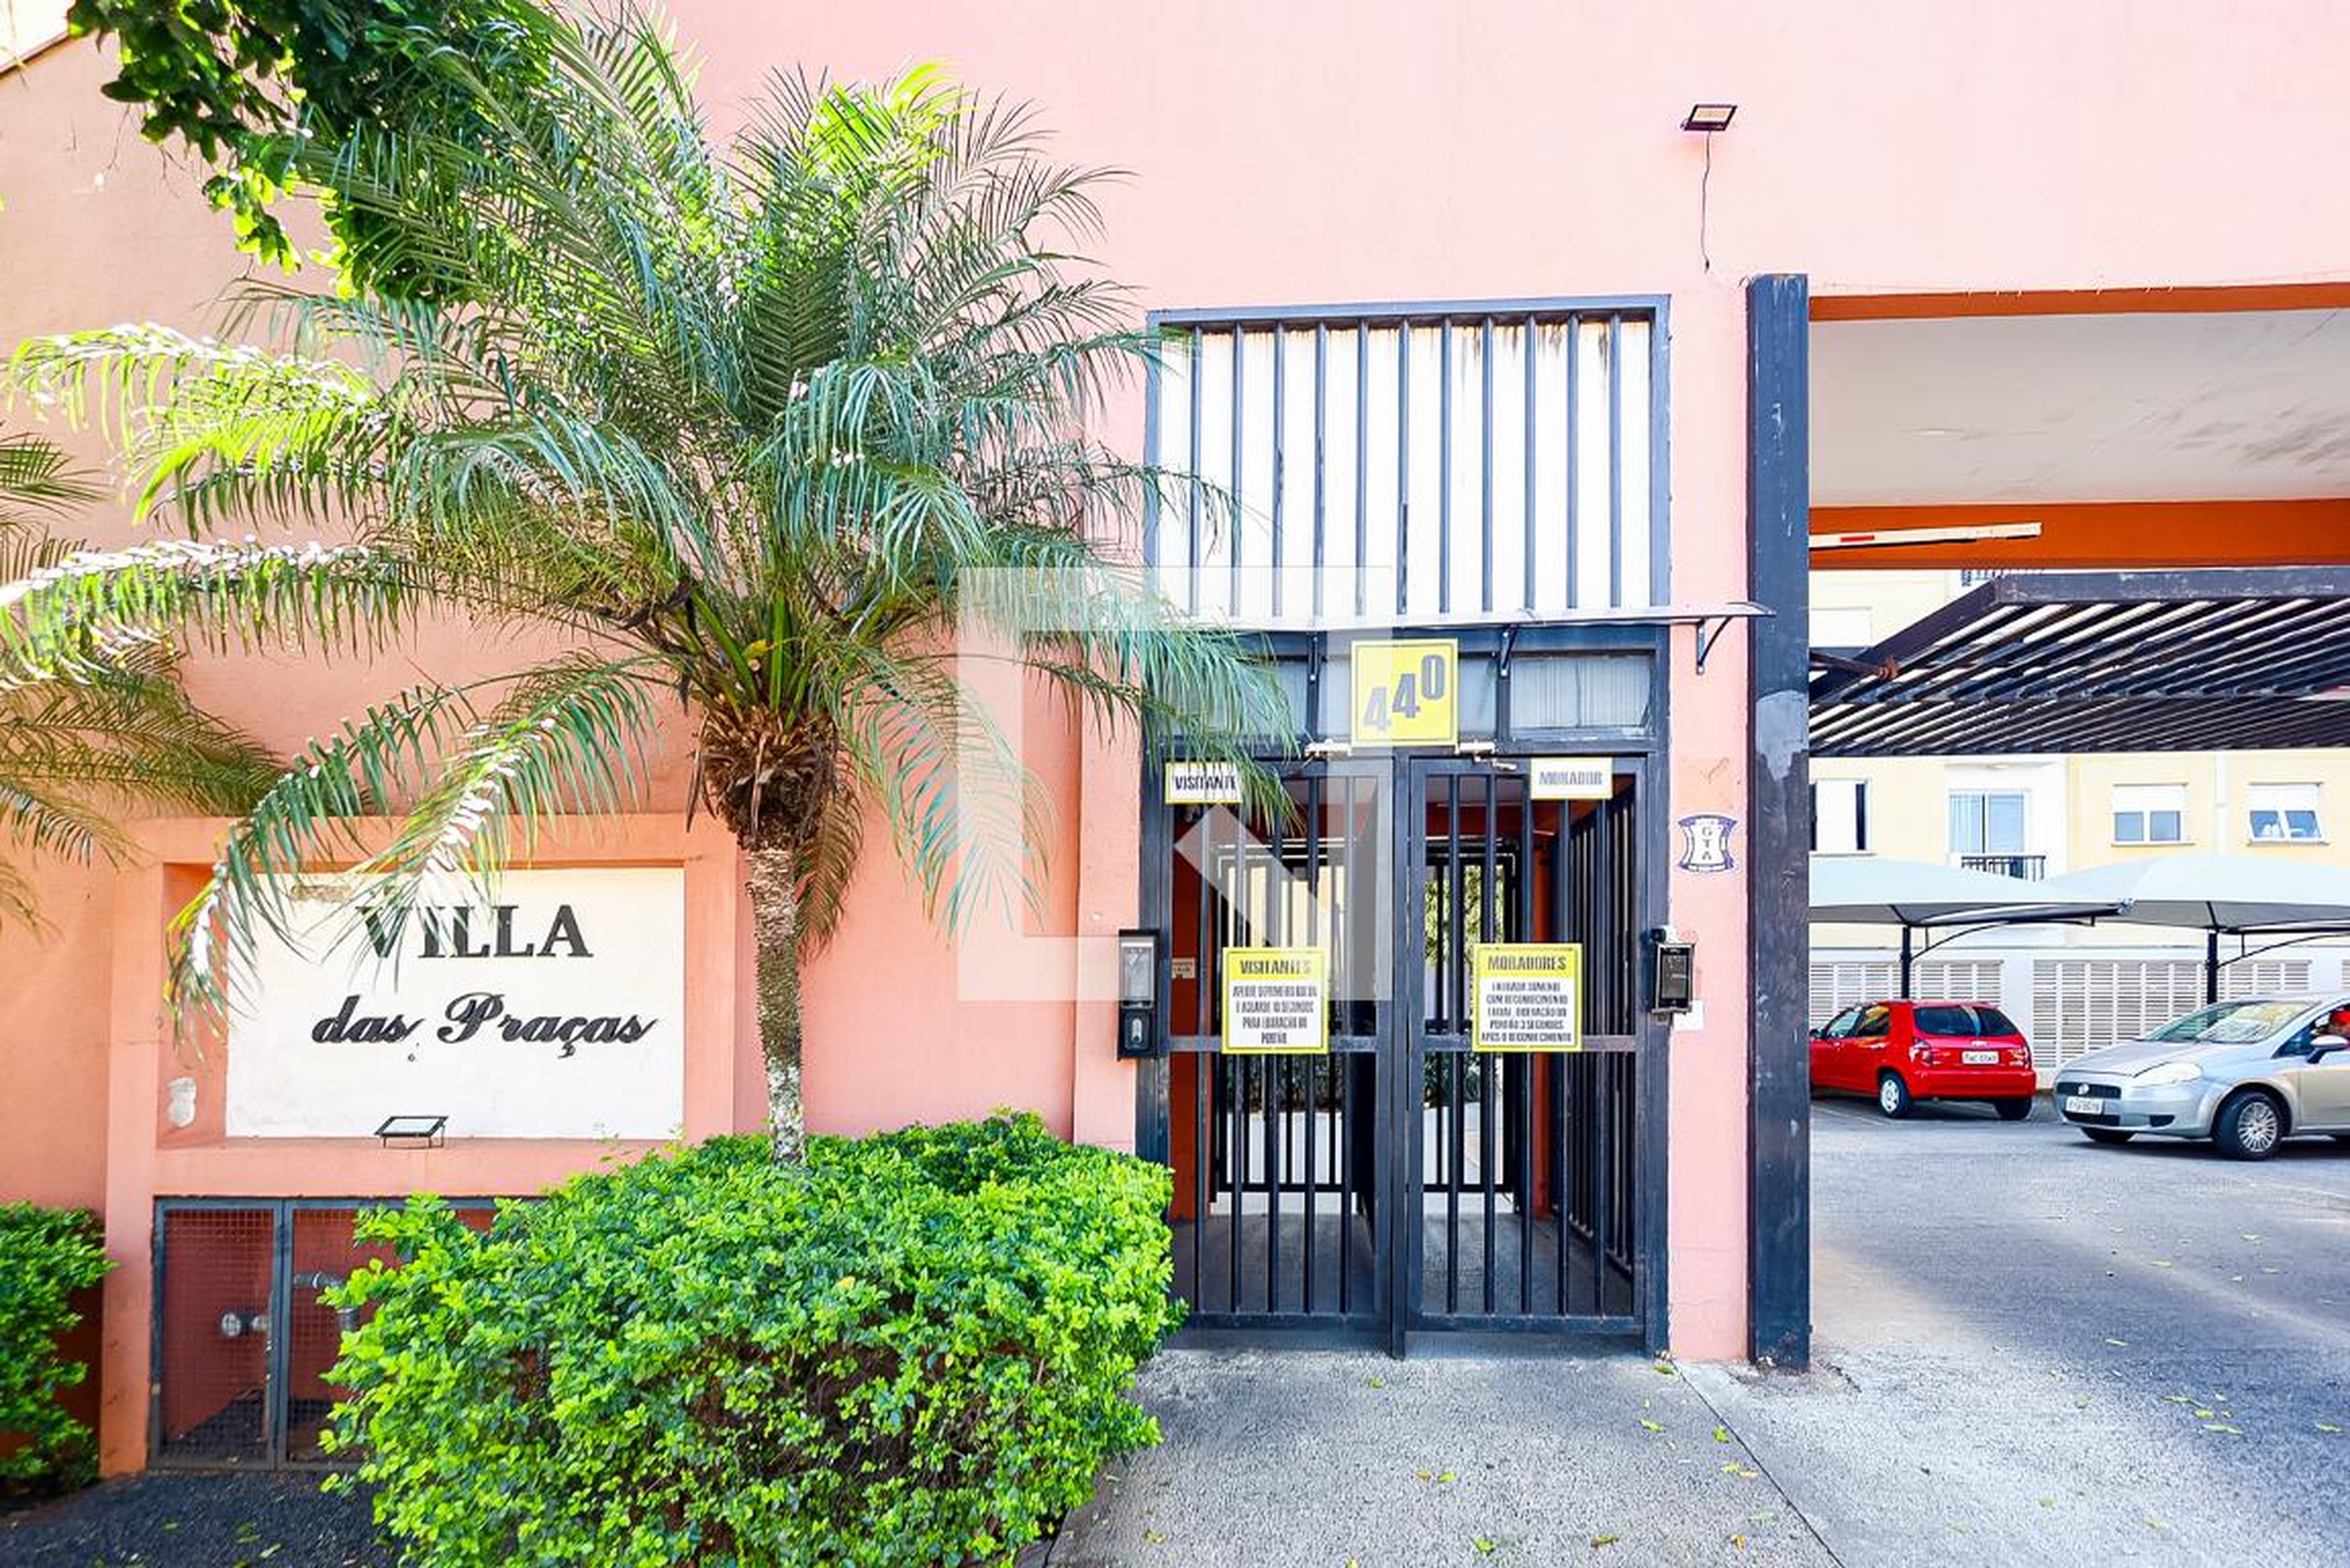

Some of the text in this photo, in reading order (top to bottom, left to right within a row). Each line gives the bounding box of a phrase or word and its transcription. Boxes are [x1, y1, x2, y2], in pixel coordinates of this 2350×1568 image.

[1364, 654, 1445, 731] 440
[1175, 775, 1236, 790] VISITANTE
[355, 903, 594, 959] VILLA
[1240, 960, 1311, 974] VISITANTES
[1487, 955, 1567, 971] MORADORES
[312, 991, 658, 1059] das Praças
